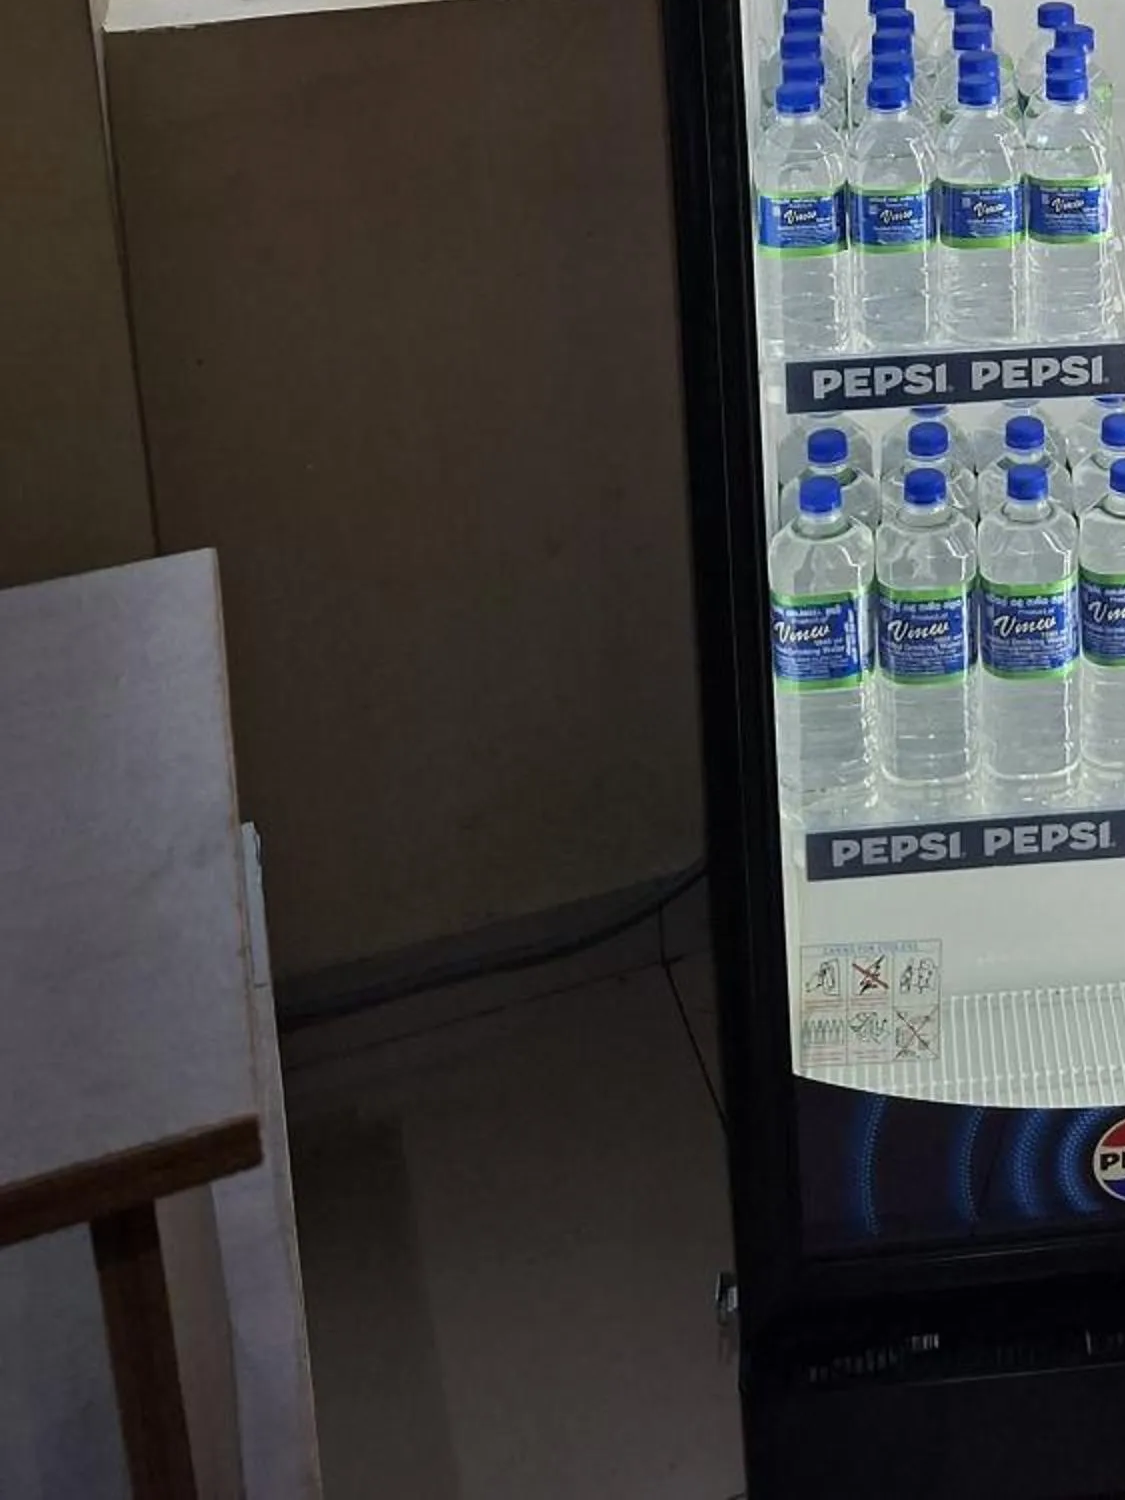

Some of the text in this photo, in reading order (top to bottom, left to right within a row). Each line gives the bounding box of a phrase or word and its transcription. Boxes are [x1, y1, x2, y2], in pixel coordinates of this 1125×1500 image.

[813, 363, 946, 399] PEPSI
[972, 356, 1102, 390] PEPSI
[832, 832, 960, 866] PEPSI
[984, 821, 1110, 856] PEPSI
